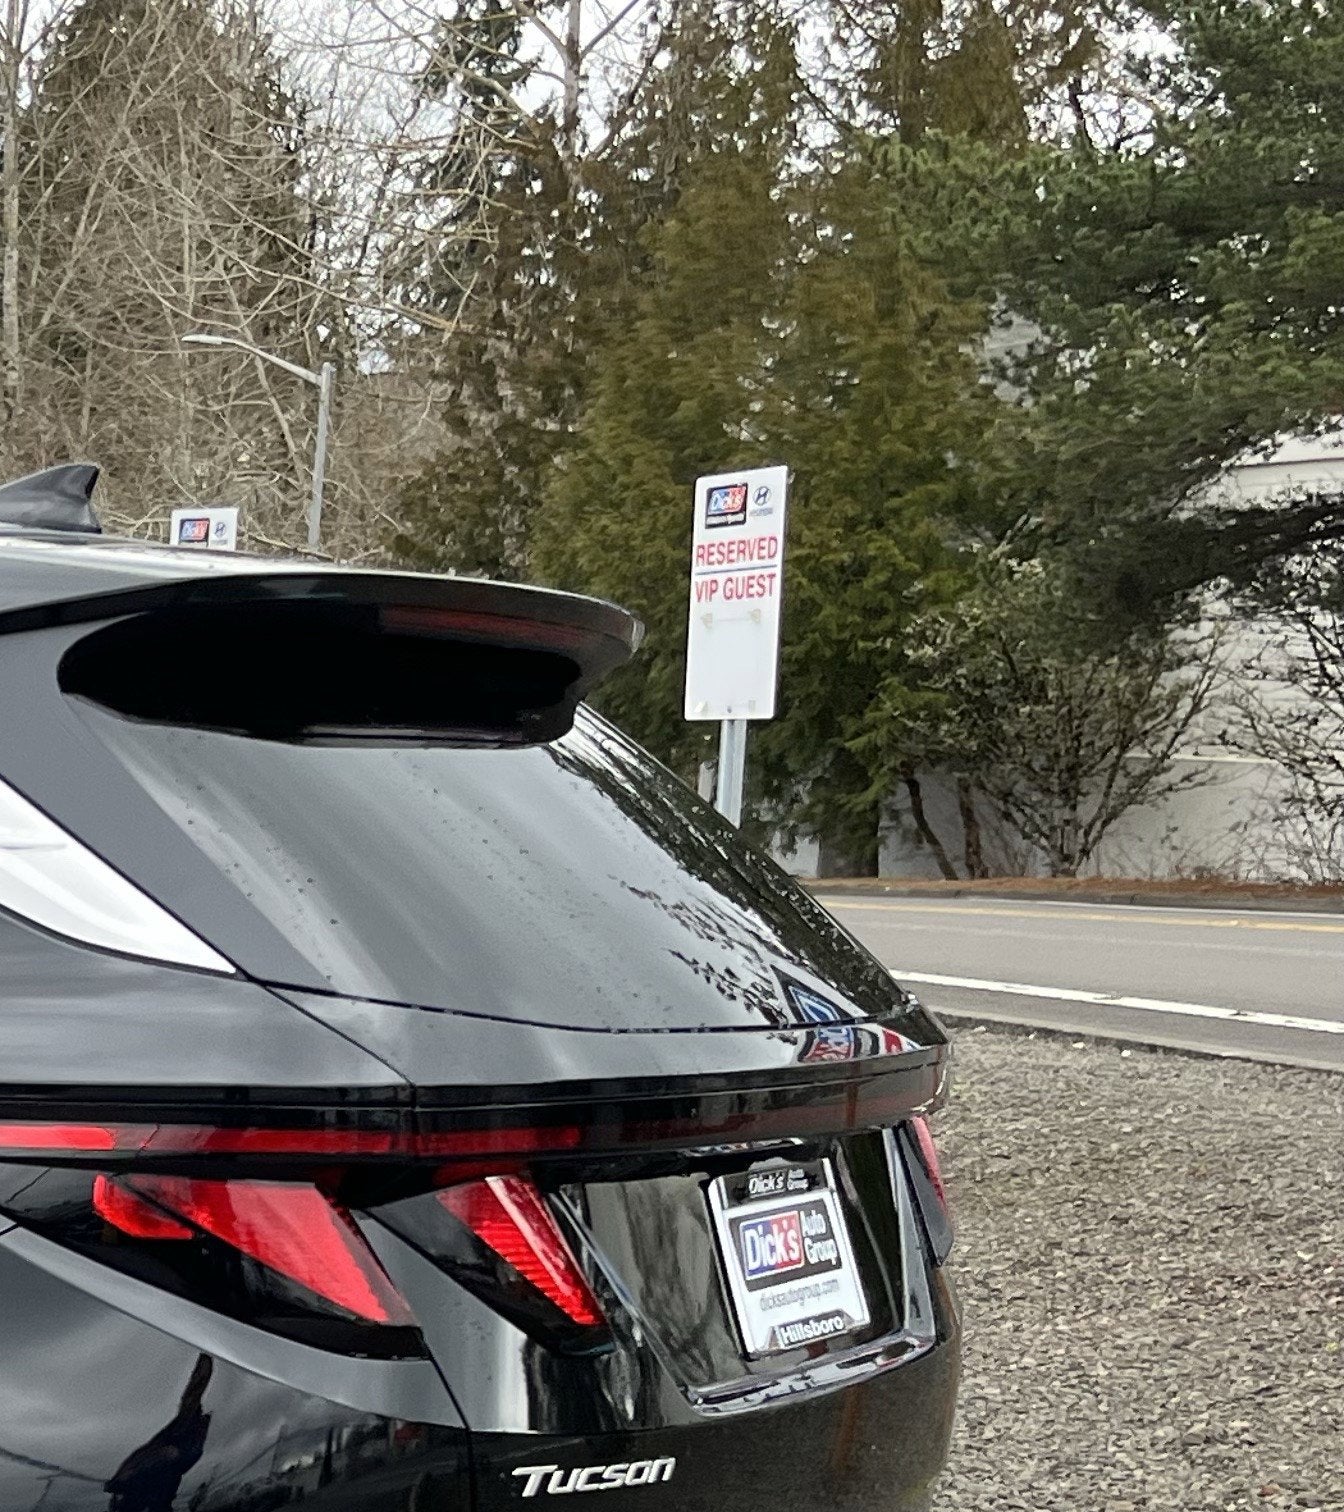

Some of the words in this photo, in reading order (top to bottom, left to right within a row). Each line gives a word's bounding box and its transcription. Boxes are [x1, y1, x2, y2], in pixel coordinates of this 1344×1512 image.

[696, 536, 778, 566] RESERVED
[695, 579, 719, 602] VIP
[723, 574, 776, 601] GUEST
[800, 1210, 827, 1237] Auto
[744, 1219, 801, 1270] Dick's
[804, 1238, 838, 1265] Group
[780, 1315, 844, 1344] Hillsboro
